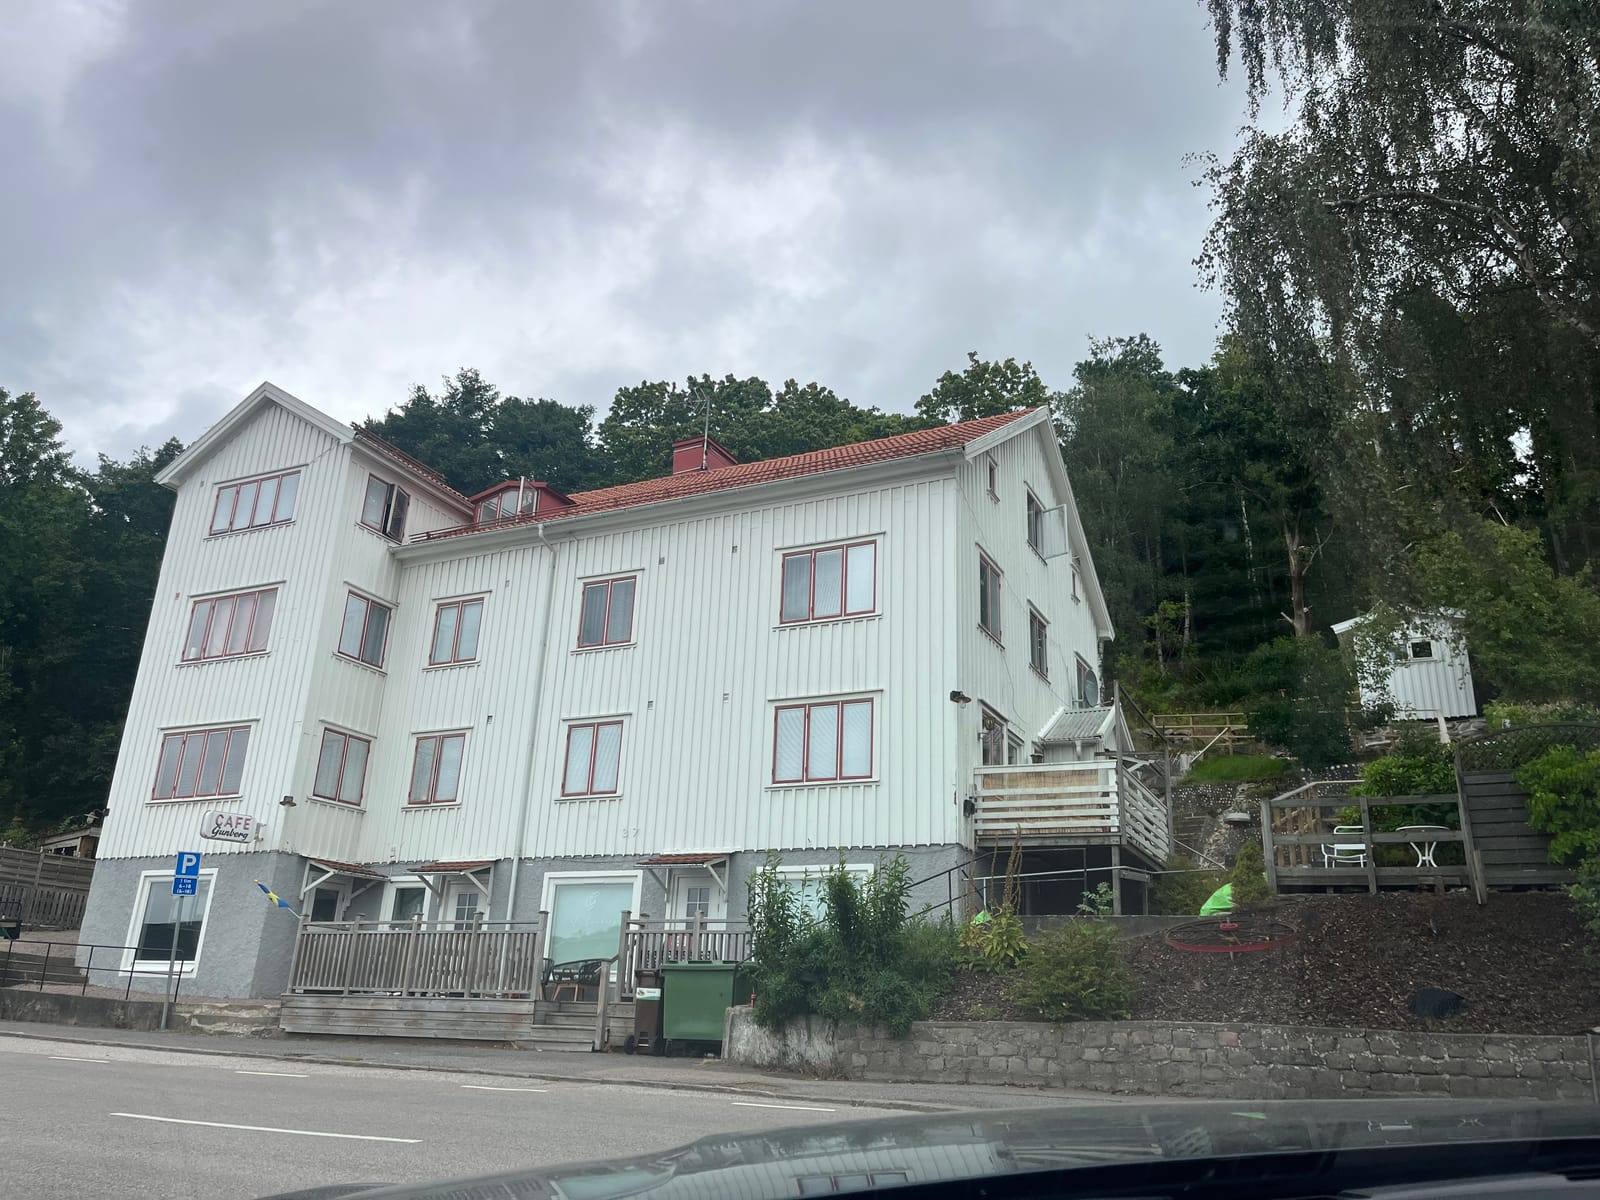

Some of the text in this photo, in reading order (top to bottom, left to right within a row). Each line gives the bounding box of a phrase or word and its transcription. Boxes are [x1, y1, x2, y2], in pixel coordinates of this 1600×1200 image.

[215, 814, 252, 830] CAFE
[211, 825, 249, 841] Gunberg
[181, 854, 197, 874] P
